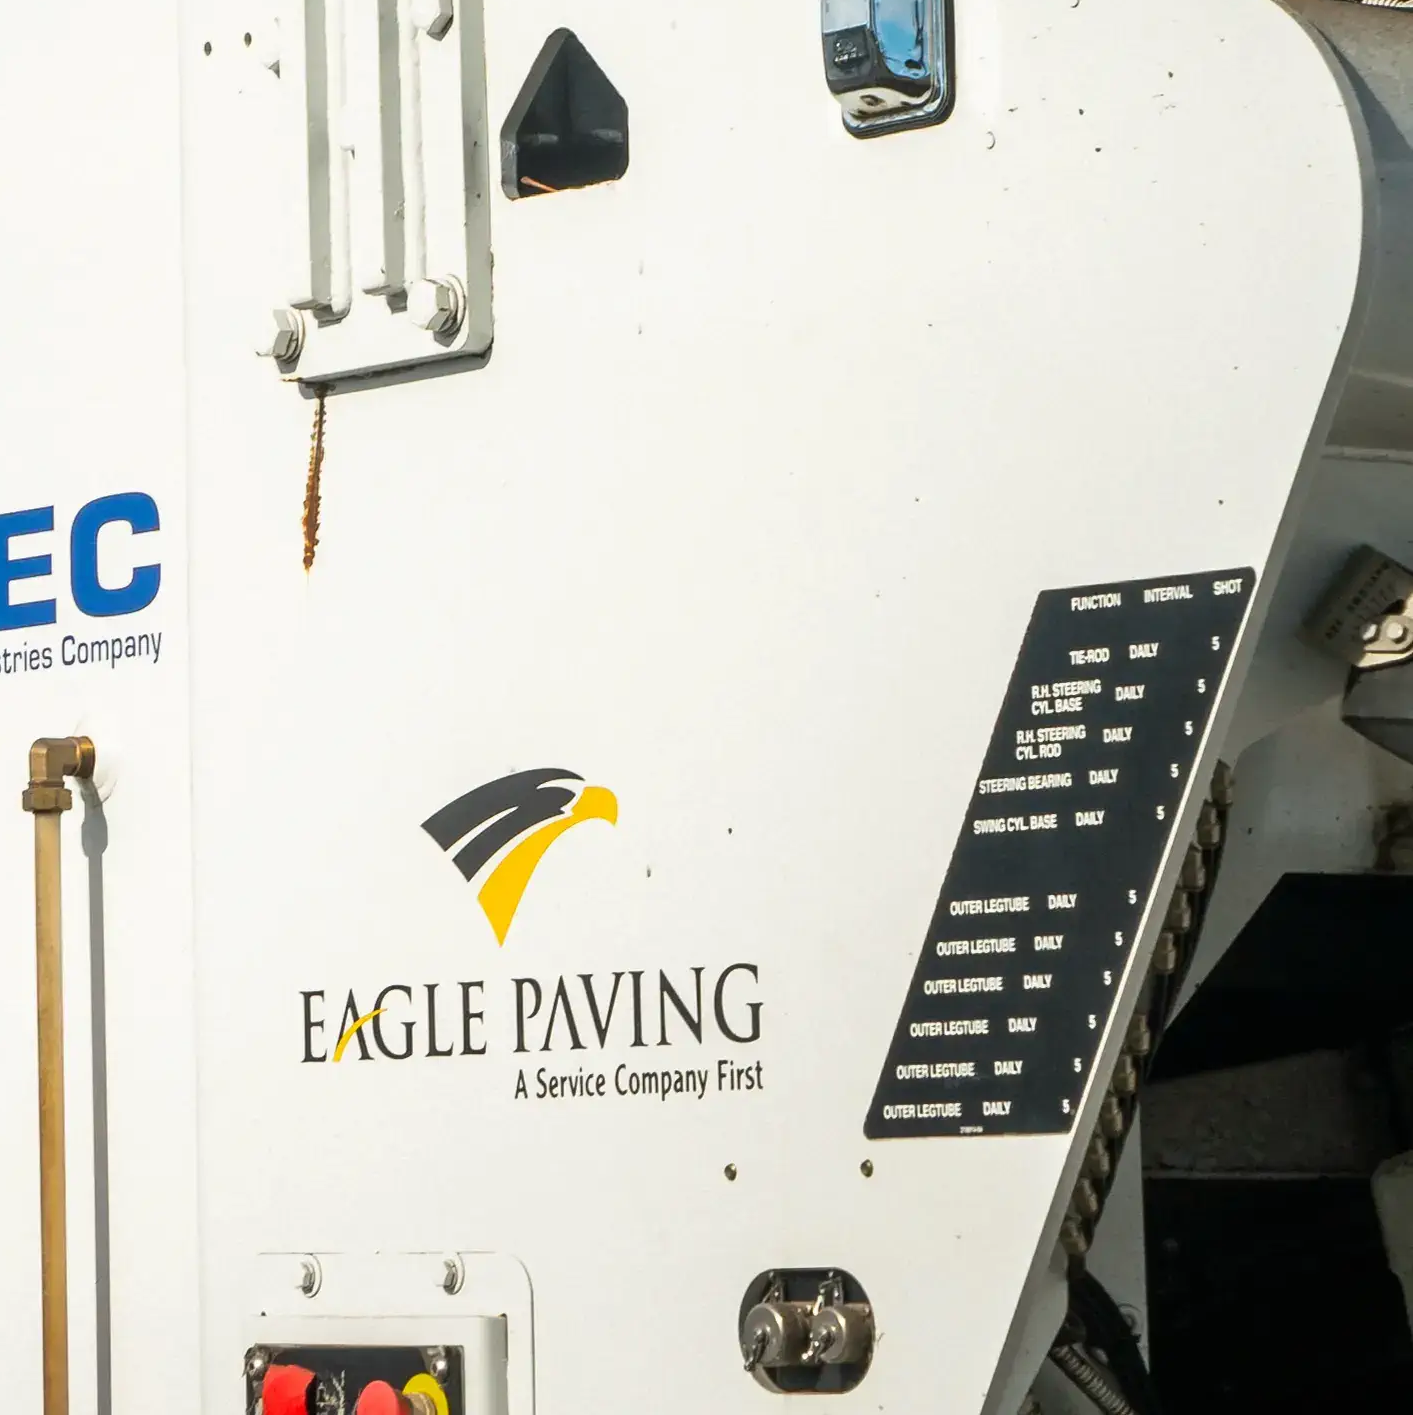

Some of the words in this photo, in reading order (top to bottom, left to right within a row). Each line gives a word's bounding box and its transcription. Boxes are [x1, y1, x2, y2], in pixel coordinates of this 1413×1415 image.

[1070, 592, 1122, 612] FUNCTION
[1143, 584, 1194, 604] INTERVAL
[1212, 578, 1244, 596] SHOT
[61, 632, 162, 669] Company
[1068, 647, 1111, 666] TIE-ROD
[1128, 642, 1160, 660] DAILY
[1211, 635, 1221, 651] 5
[1030, 683, 1052, 700] R.H.
[1051, 678, 1102, 698] STEERING
[1114, 684, 1146, 702] DAILY
[1197, 678, 1206, 694] 5
[1054, 696, 1084, 714] BASE
[1015, 729, 1037, 745] R.H.
[1036, 724, 1087, 743] STEERING
[1102, 726, 1133, 744] DAILY
[1184, 720, 1194, 736] 5
[1038, 742, 1062, 759] ROD
[978, 775, 1028, 795] STEERING
[1027, 772, 1073, 791] BEARING
[1088, 768, 1119, 786] DAILY
[1170, 763, 1180, 779] 5
[972, 817, 1007, 835] SWING
[1029, 813, 1058, 831] BASE
[1074, 810, 1106, 827] DAILY
[1156, 805, 1166, 821] 5
[949, 899, 984, 917] OUTER
[1047, 893, 1078, 910] DAILY
[1128, 889, 1138, 905] 5
[935, 940, 970, 957] OUTER
[1033, 934, 1064, 952] DAILY
[1114, 930, 1124, 947] 5
[923, 978, 958, 996] OUTER
[1022, 973, 1053, 990] DAILY
[1103, 970, 1112, 986] 5
[300, 981, 488, 1063] EAGLE
[511, 962, 764, 1053] PAVING
[909, 1021, 943, 1038] OUTER
[1007, 1016, 1038, 1033] DAILY
[1088, 1014, 1097, 1030] 5
[514, 1069, 529, 1100] A
[536, 1067, 606, 1099] Service
[614, 1063, 708, 1102] Company
[717, 1059, 764, 1091] First
[895, 1063, 930, 1081] OUTER
[993, 1060, 1024, 1076] DAILY
[1073, 1057, 1082, 1073] 5
[882, 1103, 917, 1120] OUTER
[982, 1100, 1012, 1117] DAILY
[1061, 1098, 1071, 1114] 5
